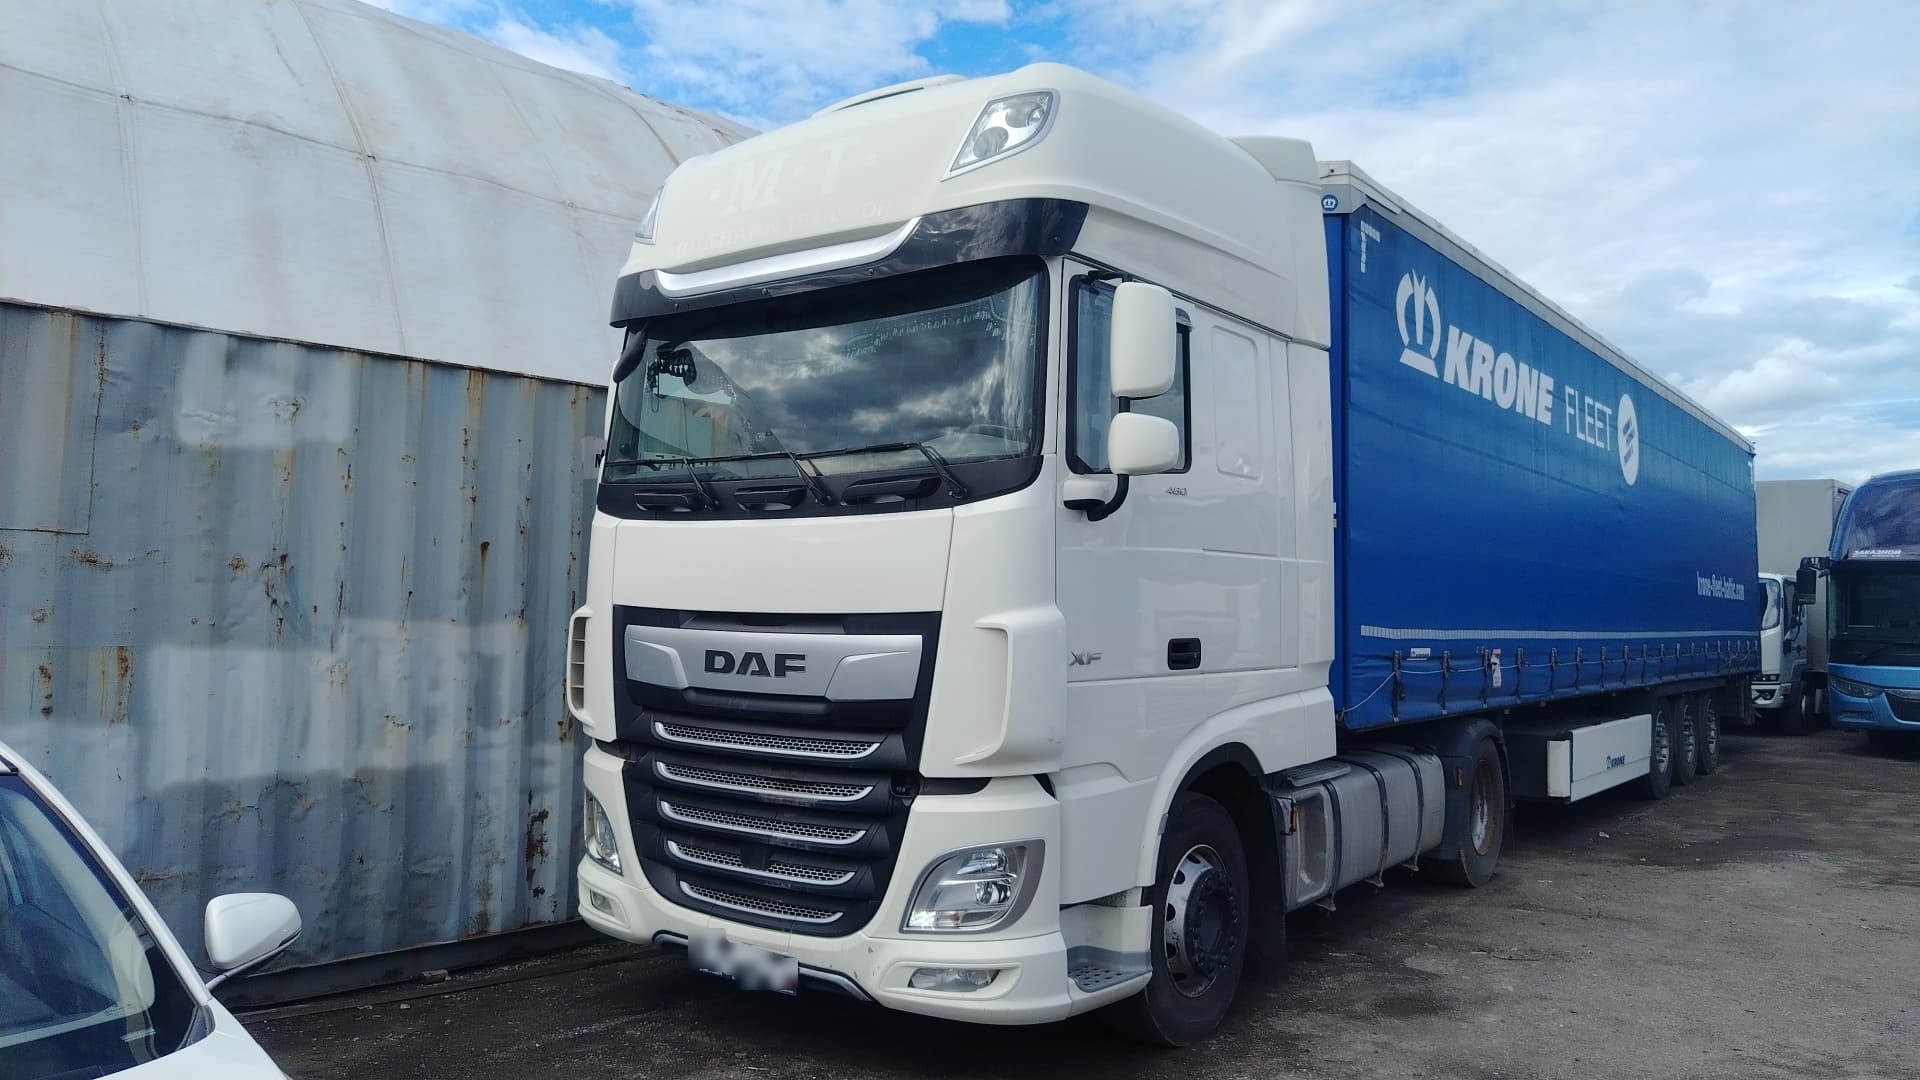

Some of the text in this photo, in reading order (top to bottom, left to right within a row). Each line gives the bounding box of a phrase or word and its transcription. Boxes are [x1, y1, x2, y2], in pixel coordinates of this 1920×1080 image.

[1443, 324, 1613, 451] KRONE FLEET
[704, 649, 806, 677] DAF
[1069, 651, 1104, 666] XF
